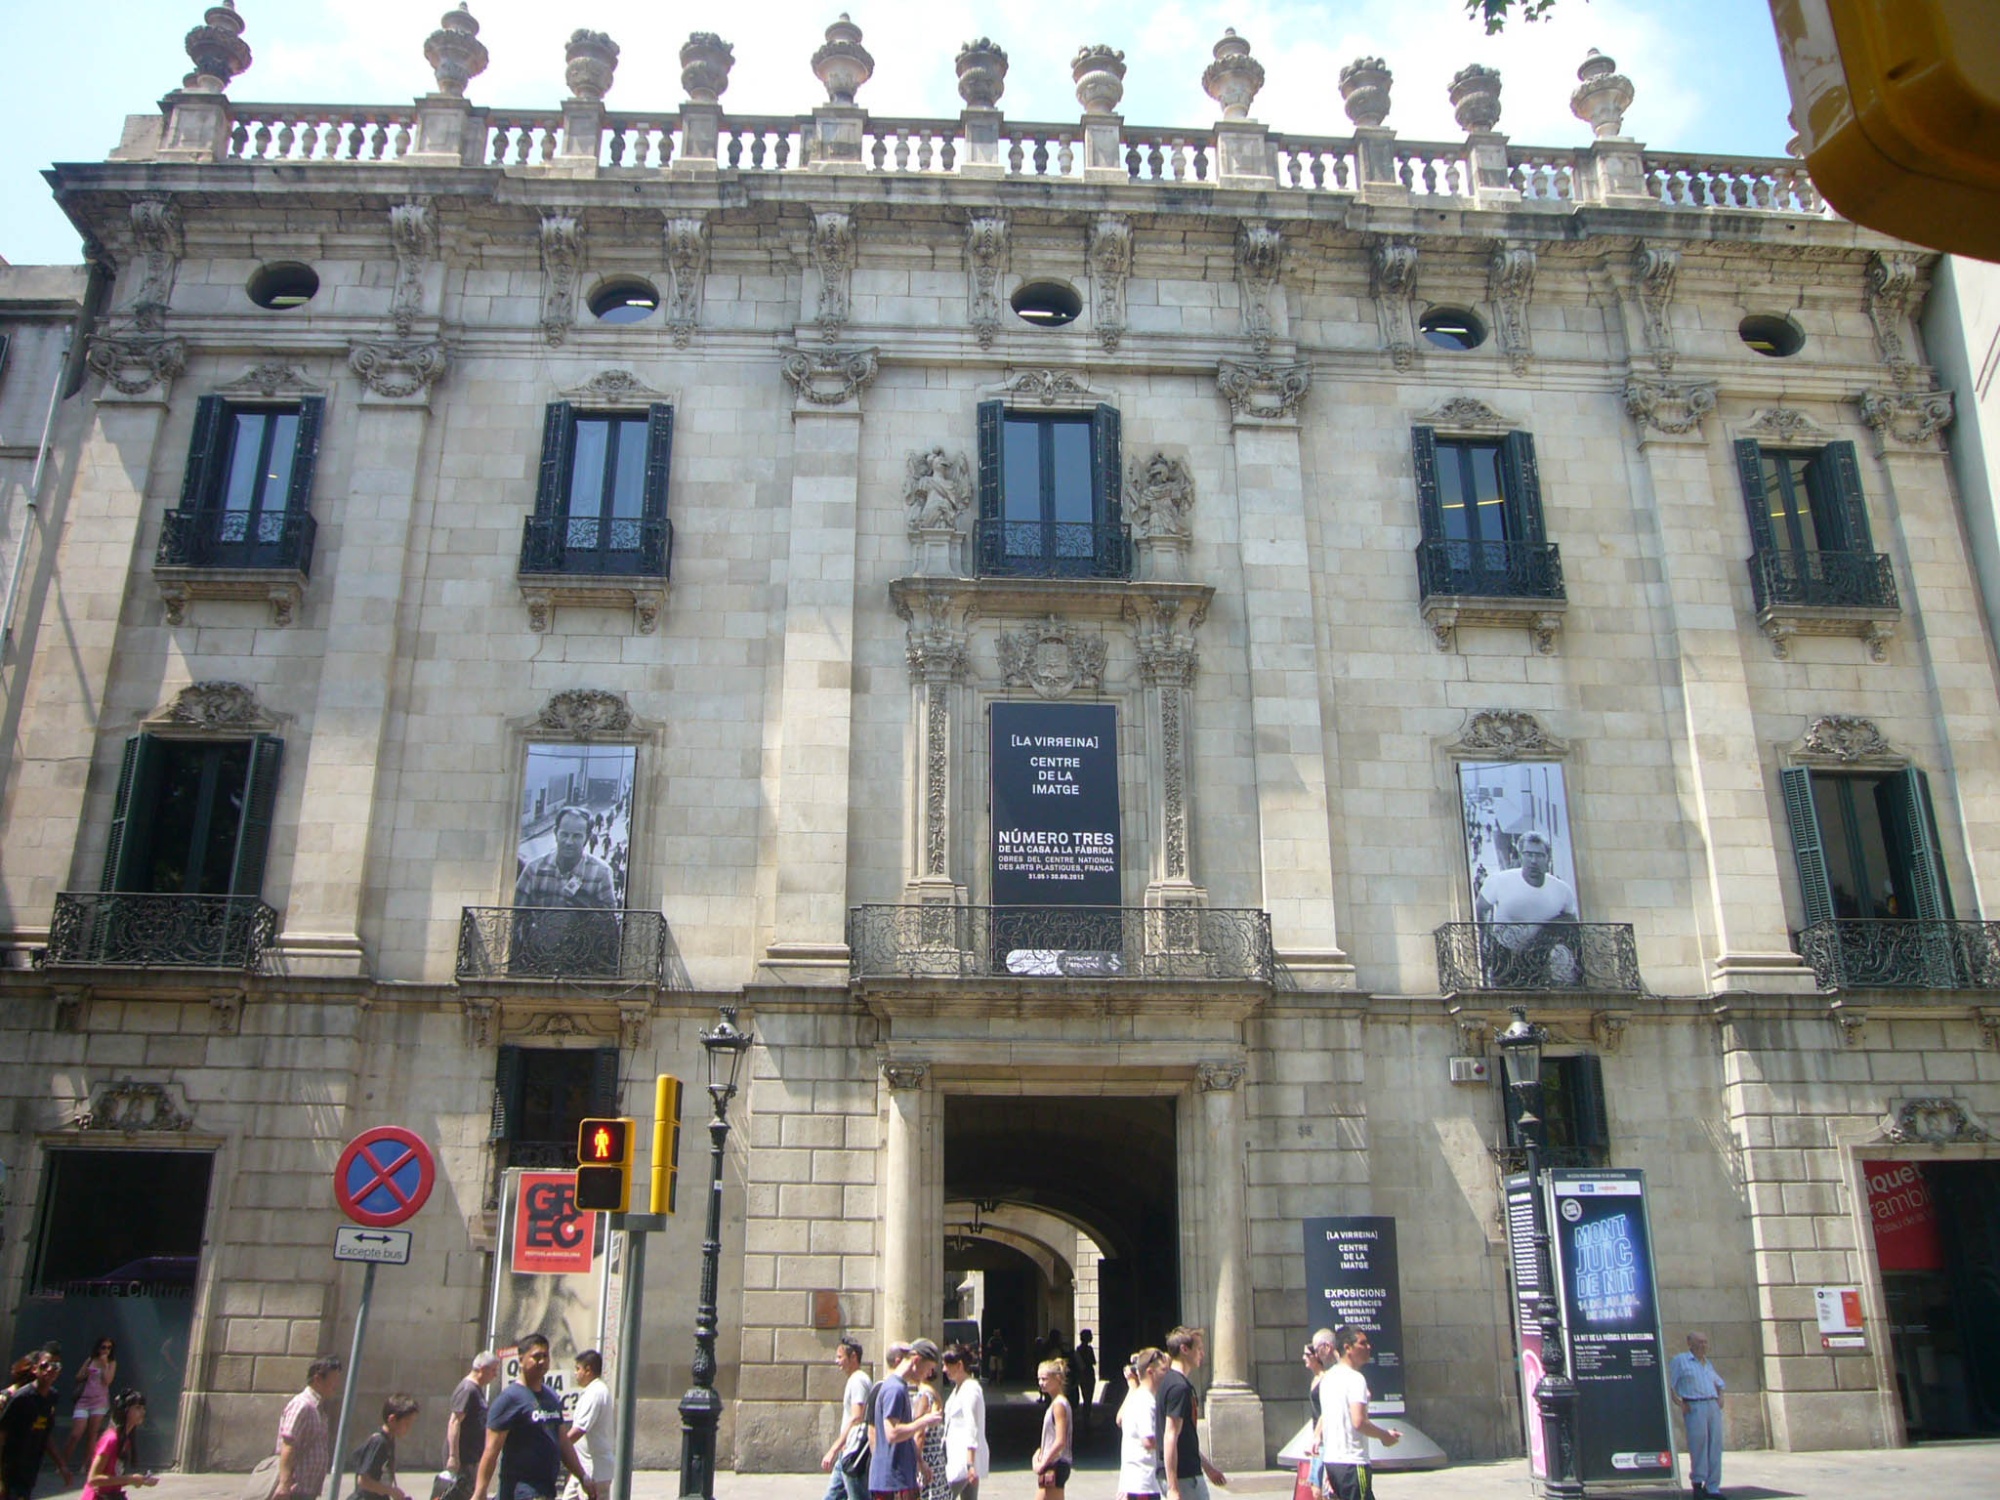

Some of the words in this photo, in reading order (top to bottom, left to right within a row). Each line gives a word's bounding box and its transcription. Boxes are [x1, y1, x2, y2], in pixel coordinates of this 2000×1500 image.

[1030, 756, 1080, 768] CENTRE
[1038, 770, 1055, 781] DE
[1057, 771, 1073, 781] LA
[1032, 784, 1080, 795] IMATGE
[999, 828, 1069, 845] NÚMERO
[1072, 832, 1114, 845] TRES
[999, 845, 1011, 853] DE
[1013, 845, 1025, 853] LA
[1026, 845, 1051, 854] CASA
[1053, 846, 1060, 854] A
[1061, 846, 1073, 854] LA
[1075, 844, 1114, 855] FÀBRICA
[998, 855, 1024, 863] OBRES
[1045, 856, 1075, 864] CENTRE
[998, 863, 1014, 871] DES
[1085, 865, 1114, 873] FRANÇA
[1574, 1214, 1626, 1248] MONT
[340, 1245, 381, 1259] Excepte
[384, 1248, 403, 1259] bus
[1338, 1244, 1368, 1252] CENTRE
[1340, 1261, 1369, 1270] IMATGE
[1577, 1273, 1599, 1298] DE
[1602, 1266, 1635, 1295] NIT
[1324, 1289, 1387, 1298] EXPOSICIONS
